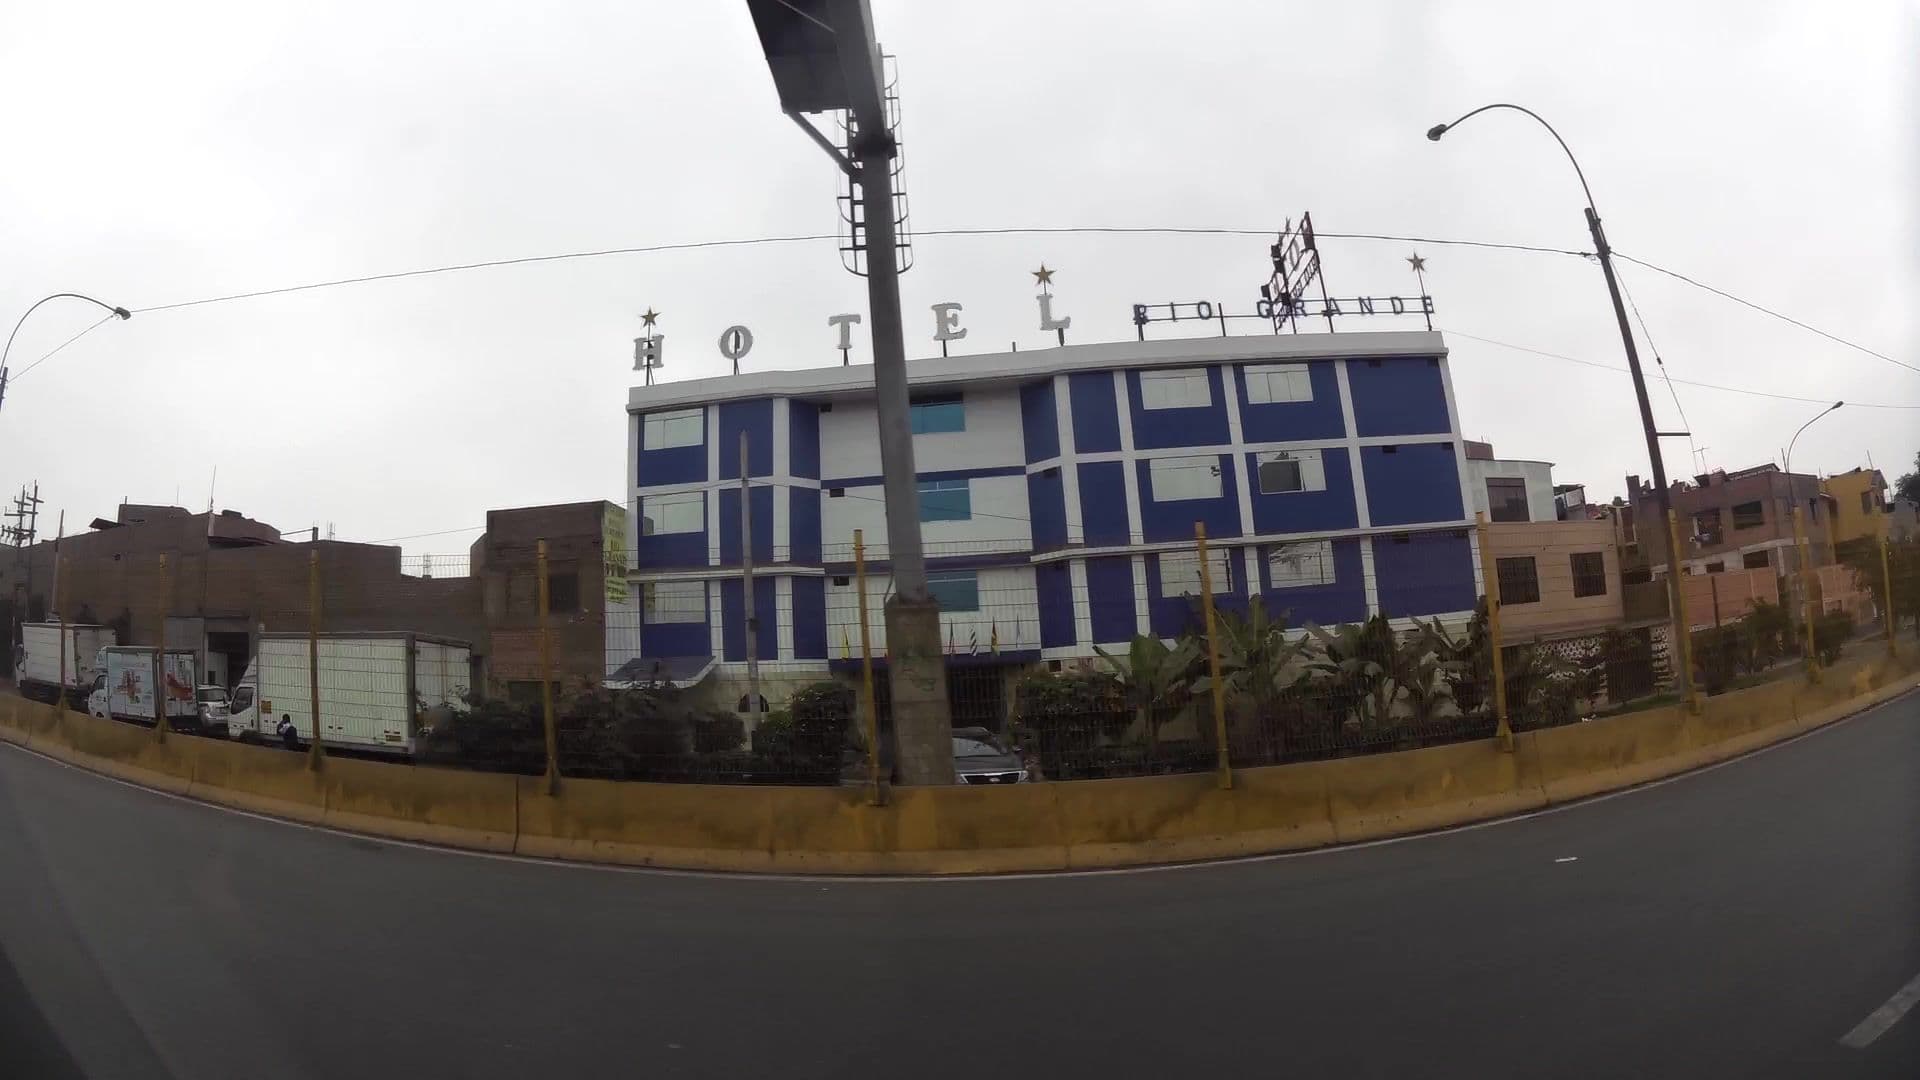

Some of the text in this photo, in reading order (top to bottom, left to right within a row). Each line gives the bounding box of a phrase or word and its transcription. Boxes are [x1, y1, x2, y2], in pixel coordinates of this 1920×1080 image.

[632, 294, 1434, 371] HOTEL RIO GRANDE
